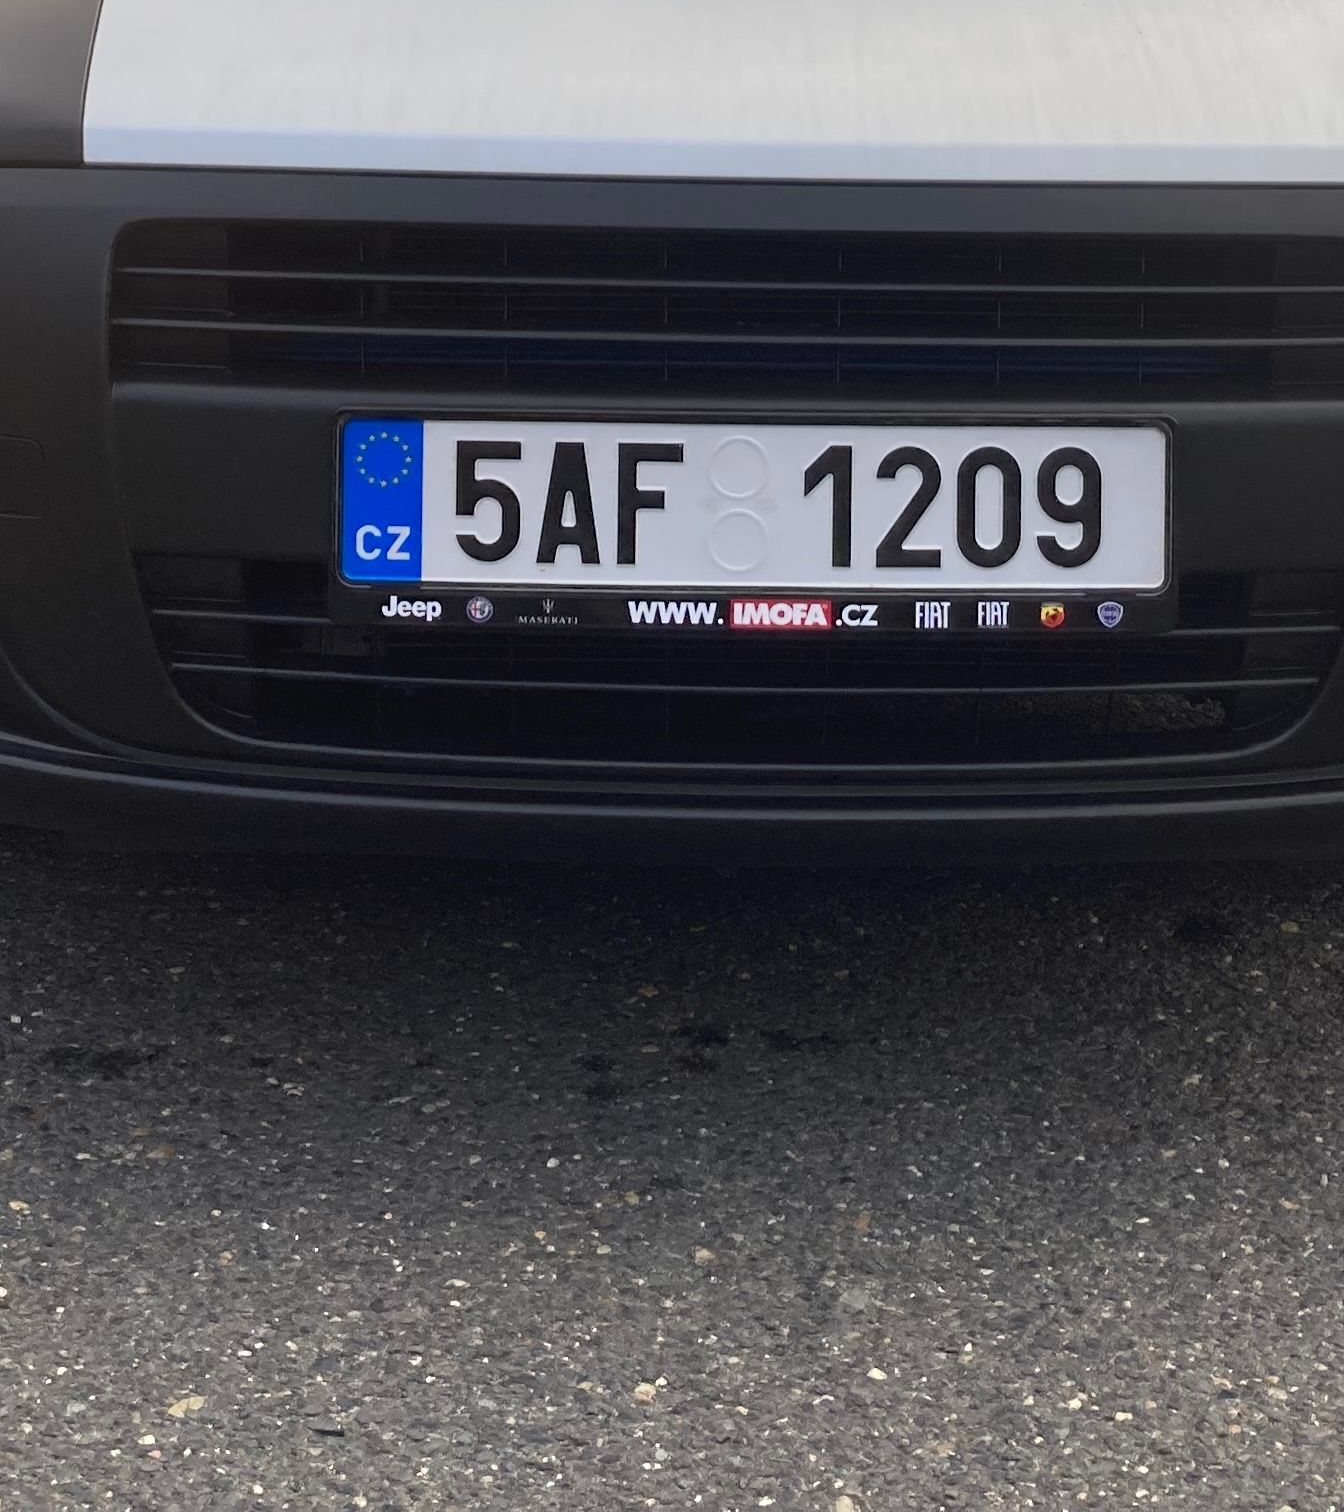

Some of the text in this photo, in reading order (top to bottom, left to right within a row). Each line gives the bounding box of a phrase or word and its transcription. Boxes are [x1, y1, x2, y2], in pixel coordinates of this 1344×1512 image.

[455, 440, 1102, 568] 5AF 1209
[356, 524, 411, 561] CZ
[381, 594, 442, 622] Jeep
[915, 601, 951, 629] FIAT
[977, 601, 1010, 626] FIAT
